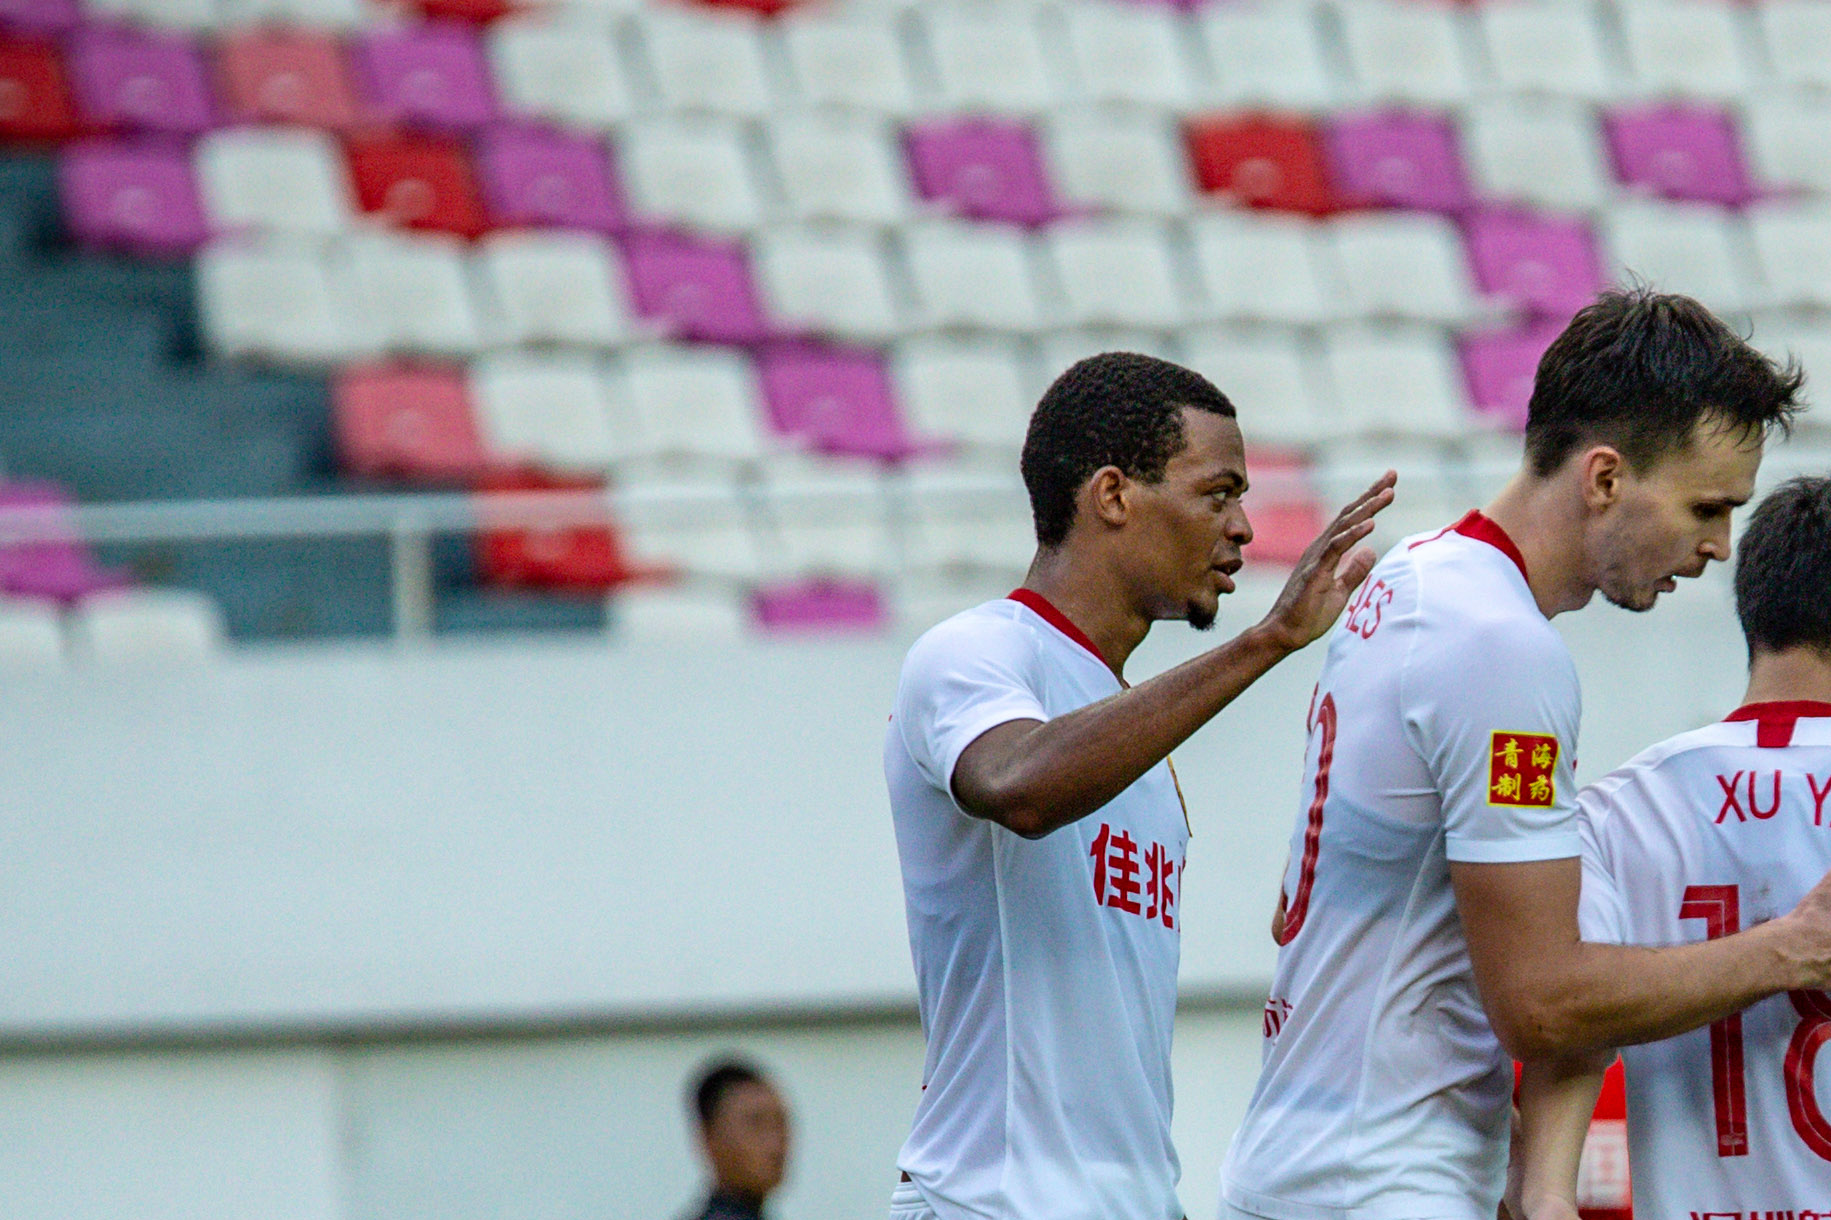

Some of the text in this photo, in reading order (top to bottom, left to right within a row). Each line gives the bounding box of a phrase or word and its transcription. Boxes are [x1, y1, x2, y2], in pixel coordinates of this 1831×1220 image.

[1494, 738, 1553, 769] 青海
[1714, 769, 1782, 824] XU
[1090, 822, 1187, 933] 佳兆
